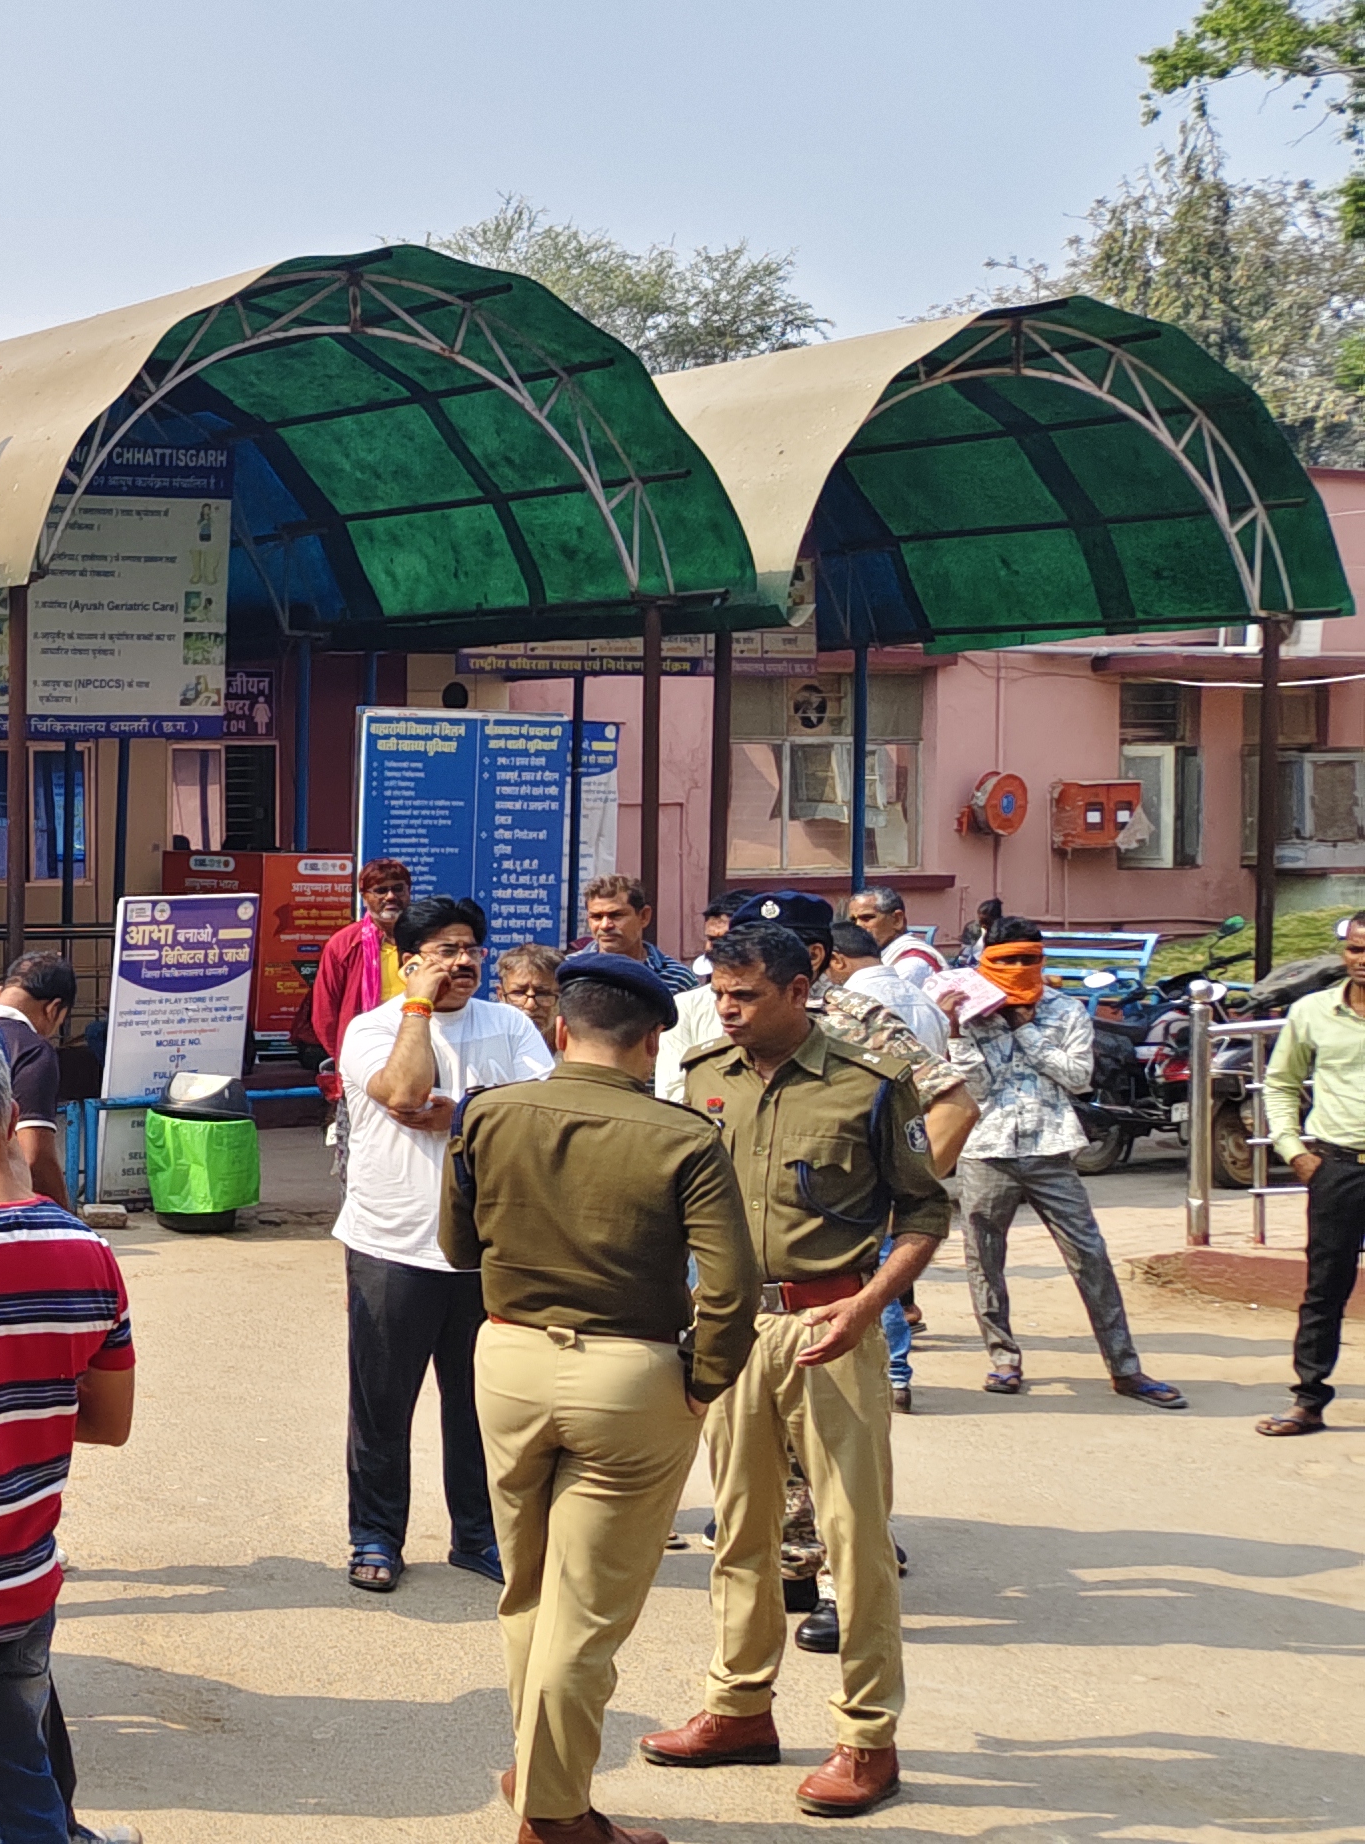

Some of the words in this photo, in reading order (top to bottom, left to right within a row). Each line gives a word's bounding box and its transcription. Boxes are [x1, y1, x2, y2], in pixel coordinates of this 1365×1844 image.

[112, 448, 228, 468] CHHATTISGARH
[134, 474, 170, 490] कार्यक्रम
[69, 600, 104, 613] (Ayush
[107, 600, 150, 612] Geriatric
[152, 601, 179, 613] Care)
[469, 655, 506, 672] राष्ट्रीय
[584, 654, 601, 672] एवं
[602, 655, 644, 672] नियंत्रण
[74, 678, 125, 691] (NPCDCS)
[225, 672, 270, 695] जीयन
[30, 717, 106, 734] चिकित्सालय
[110, 717, 149, 733] धमतरी
[550, 724, 563, 737] की
[291, 882, 331, 895] आयुष्मान
[125, 923, 176, 945] आभा
[176, 923, 217, 944] बनाओ,
[161, 946, 206, 965] डिजिटल
[207, 945, 219, 964] हो
[221, 943, 250, 963] जाओ
[164, 997, 182, 1005] PLAY
[183, 996, 206, 1004] STORE
[155, 1039, 186, 1047] MOBILE
[188, 1038, 202, 1046] NO.
[169, 1054, 186, 1063] OTP
[121, 1167, 148, 1177] SELEC
